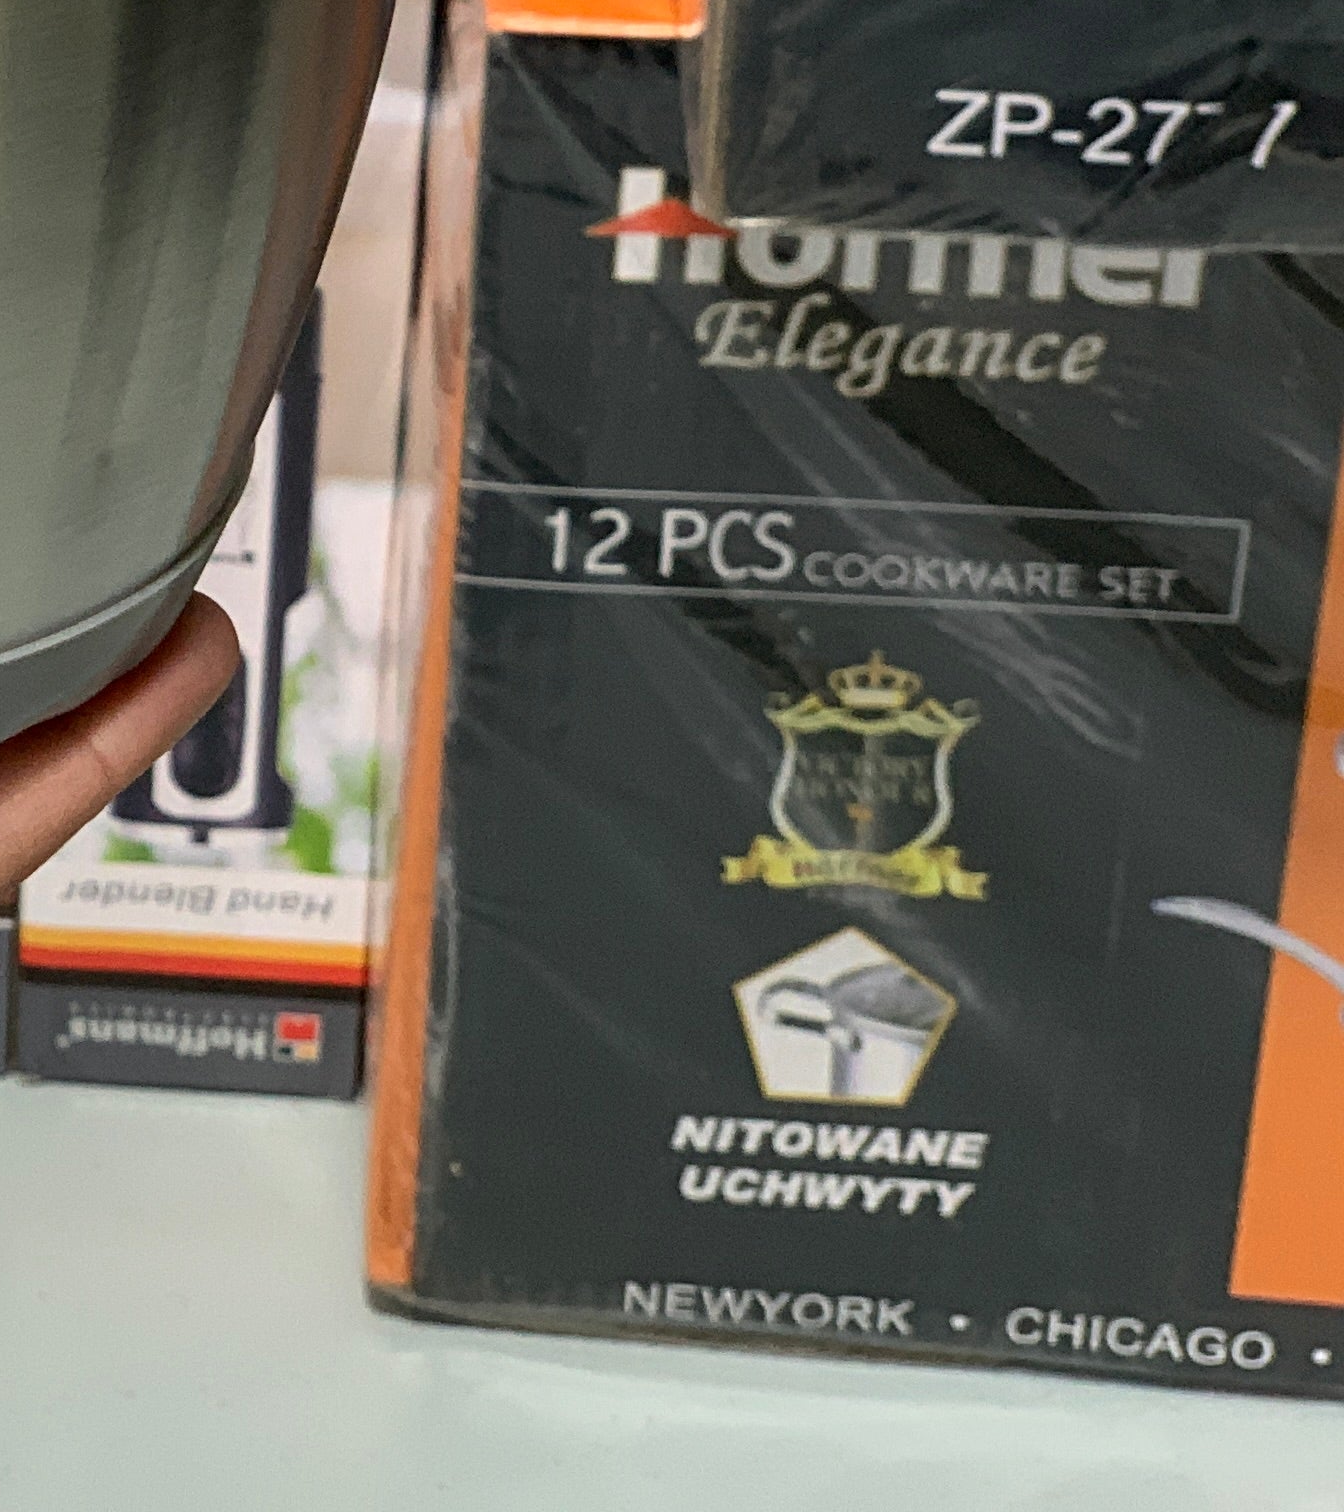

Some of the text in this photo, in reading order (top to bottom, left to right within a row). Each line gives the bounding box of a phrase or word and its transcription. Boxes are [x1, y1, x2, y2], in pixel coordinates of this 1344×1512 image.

[693, 294, 1108, 399] Elegance
[546, 508, 1179, 605] 12 PCS COOKWARE SET
[62, 879, 334, 922] Hand Blender
[671, 1115, 989, 1170] NITOWANE
[679, 1166, 976, 1219] UCHWYTY
[622, 1282, 1277, 1371] NEWYORK CHICAGO
